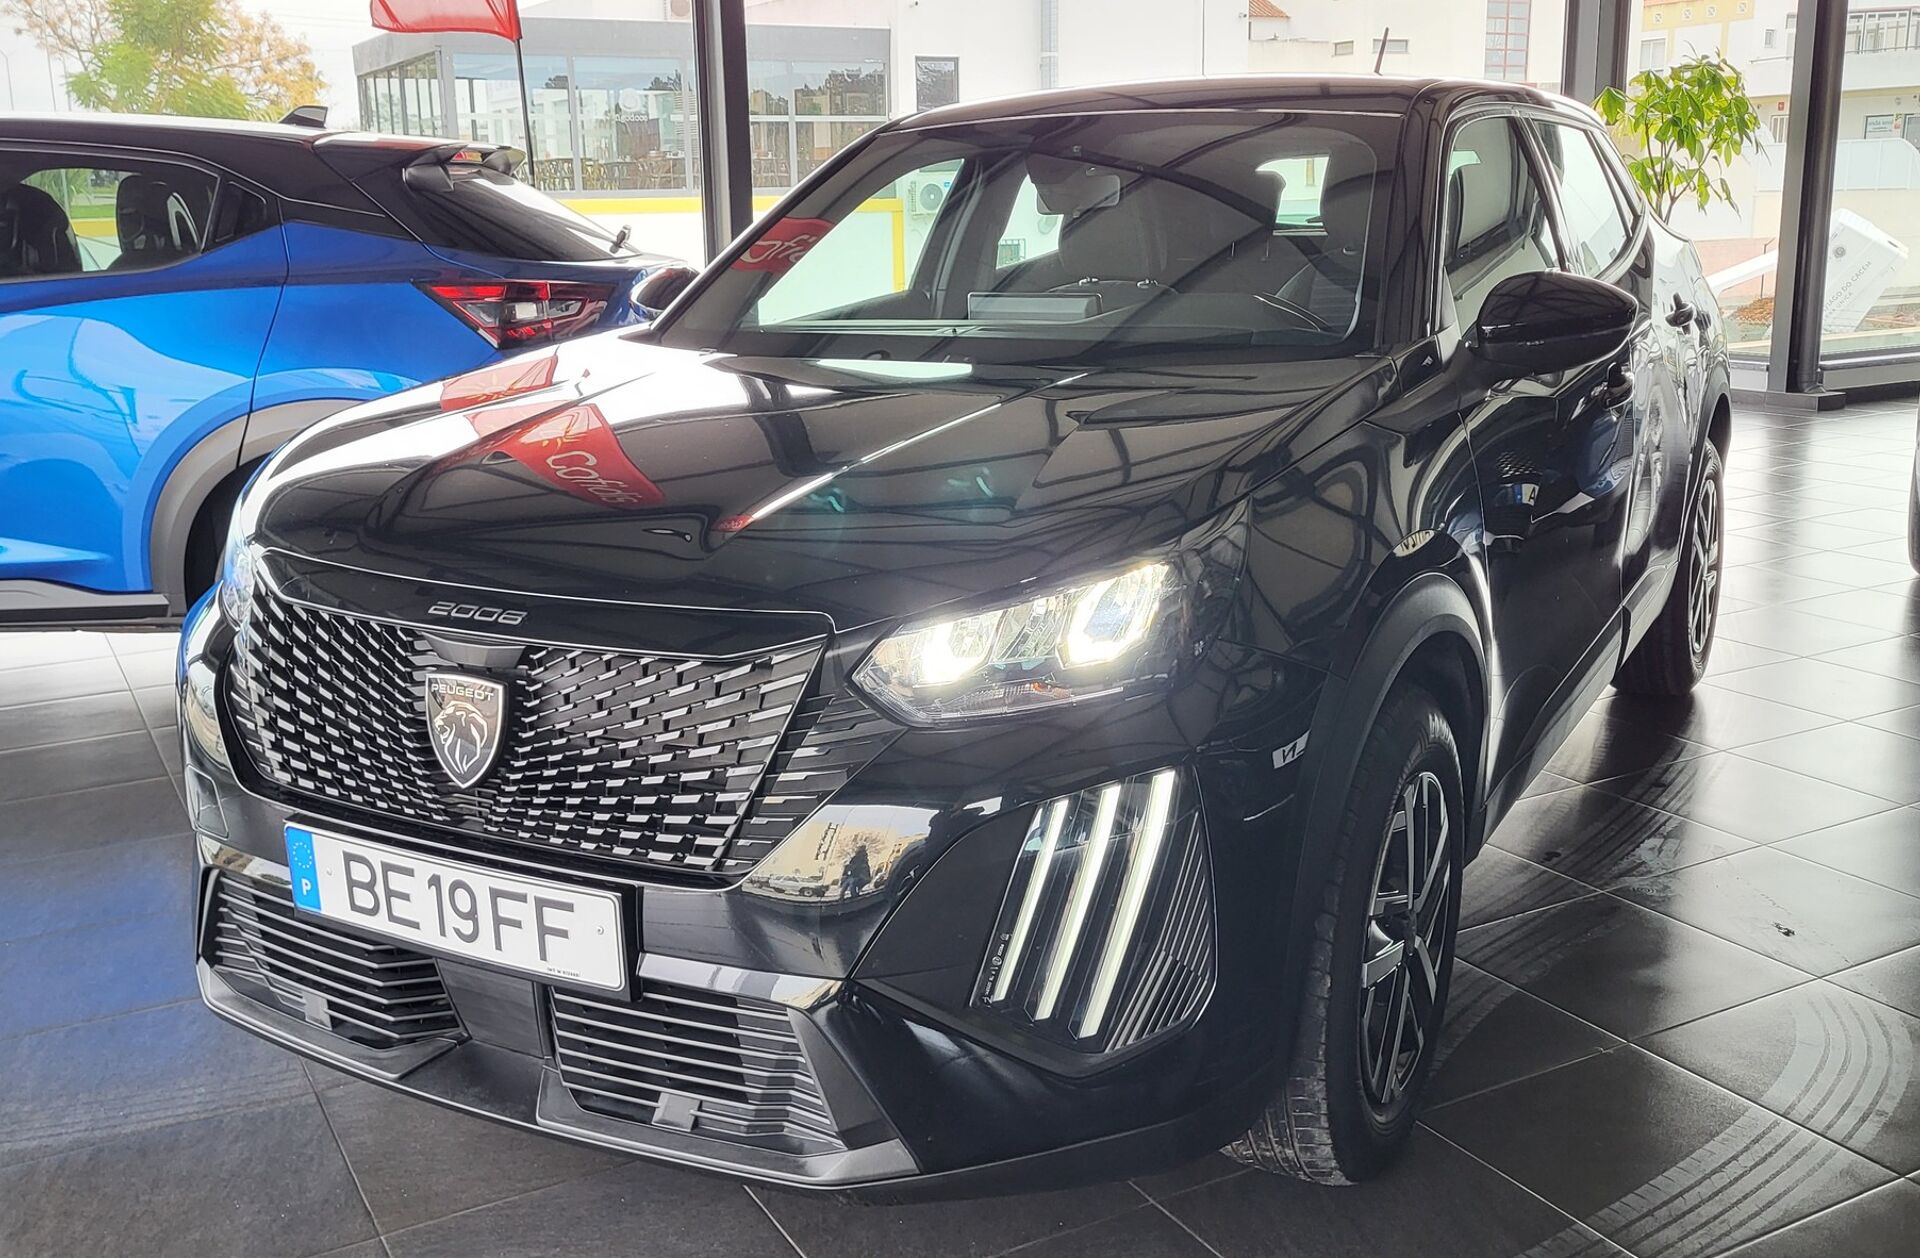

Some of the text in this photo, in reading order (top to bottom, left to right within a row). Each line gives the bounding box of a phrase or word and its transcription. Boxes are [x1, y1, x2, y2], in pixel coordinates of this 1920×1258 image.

[427, 601, 528, 625] 2008
[431, 683, 495, 701] PEUGEOT
[301, 878, 312, 896] P
